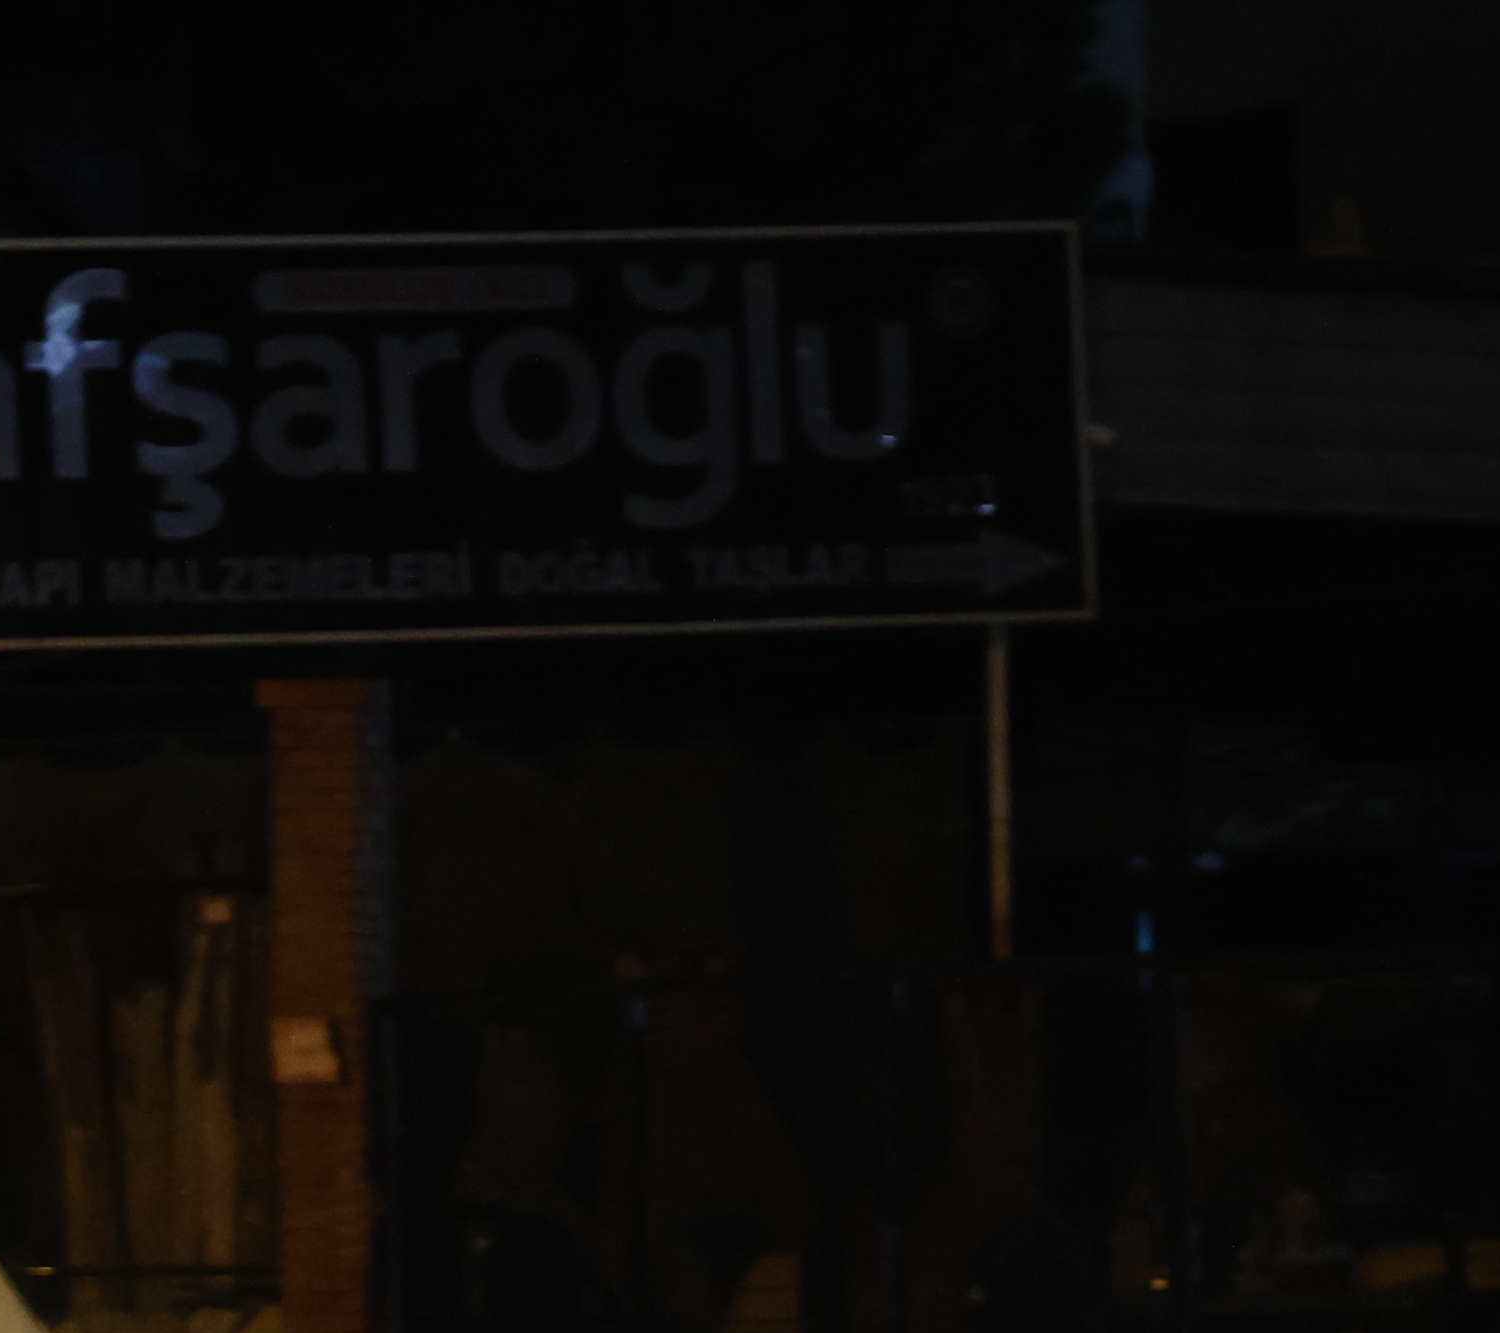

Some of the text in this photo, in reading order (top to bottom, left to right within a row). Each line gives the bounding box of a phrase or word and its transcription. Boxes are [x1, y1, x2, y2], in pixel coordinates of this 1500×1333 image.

[105, 538, 475, 608] MALZEMELERİ
[498, 538, 664, 596] DOĞAL
[683, 542, 870, 594] TAŞLAR
